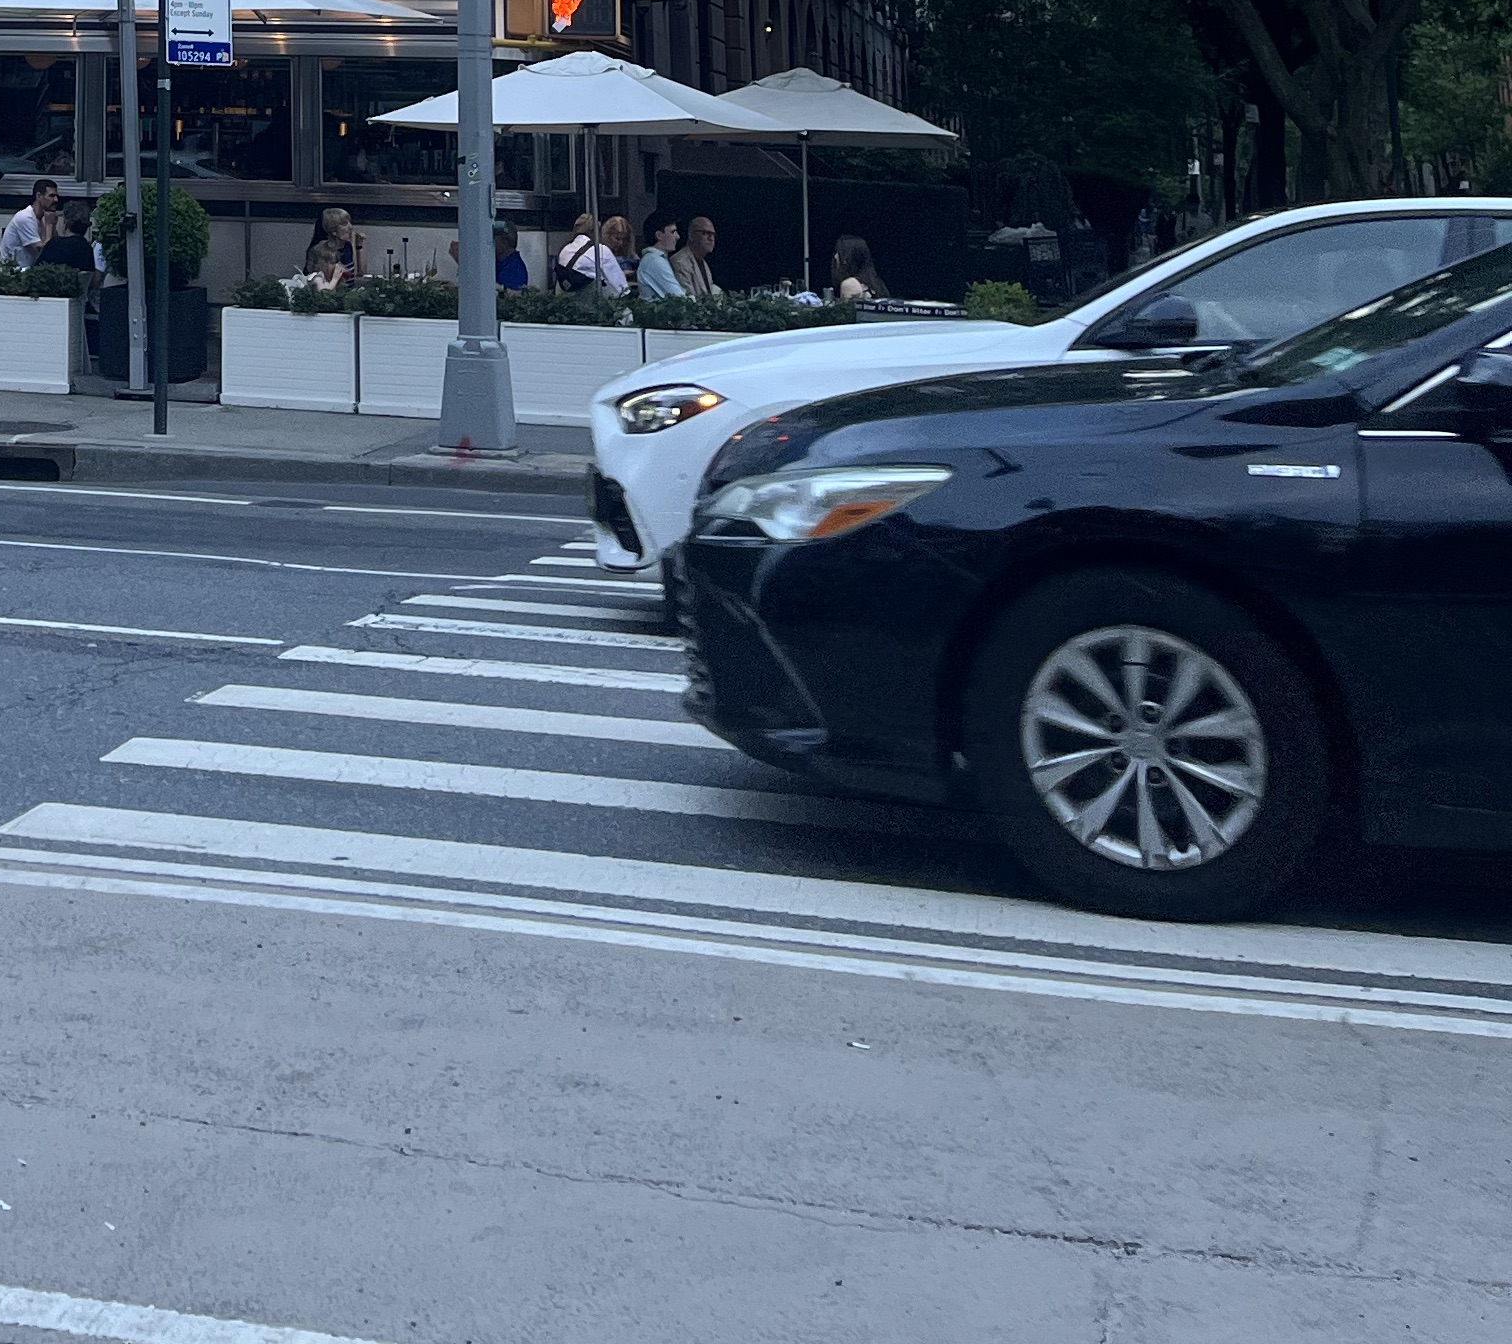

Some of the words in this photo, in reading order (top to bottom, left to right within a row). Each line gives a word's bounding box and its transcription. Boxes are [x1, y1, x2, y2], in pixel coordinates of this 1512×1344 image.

[170, 0, 183, 9] 4pm
[170, 8, 190, 17] Except
[191, 10, 214, 19] Sunday
[177, 50, 211, 62] 105294
